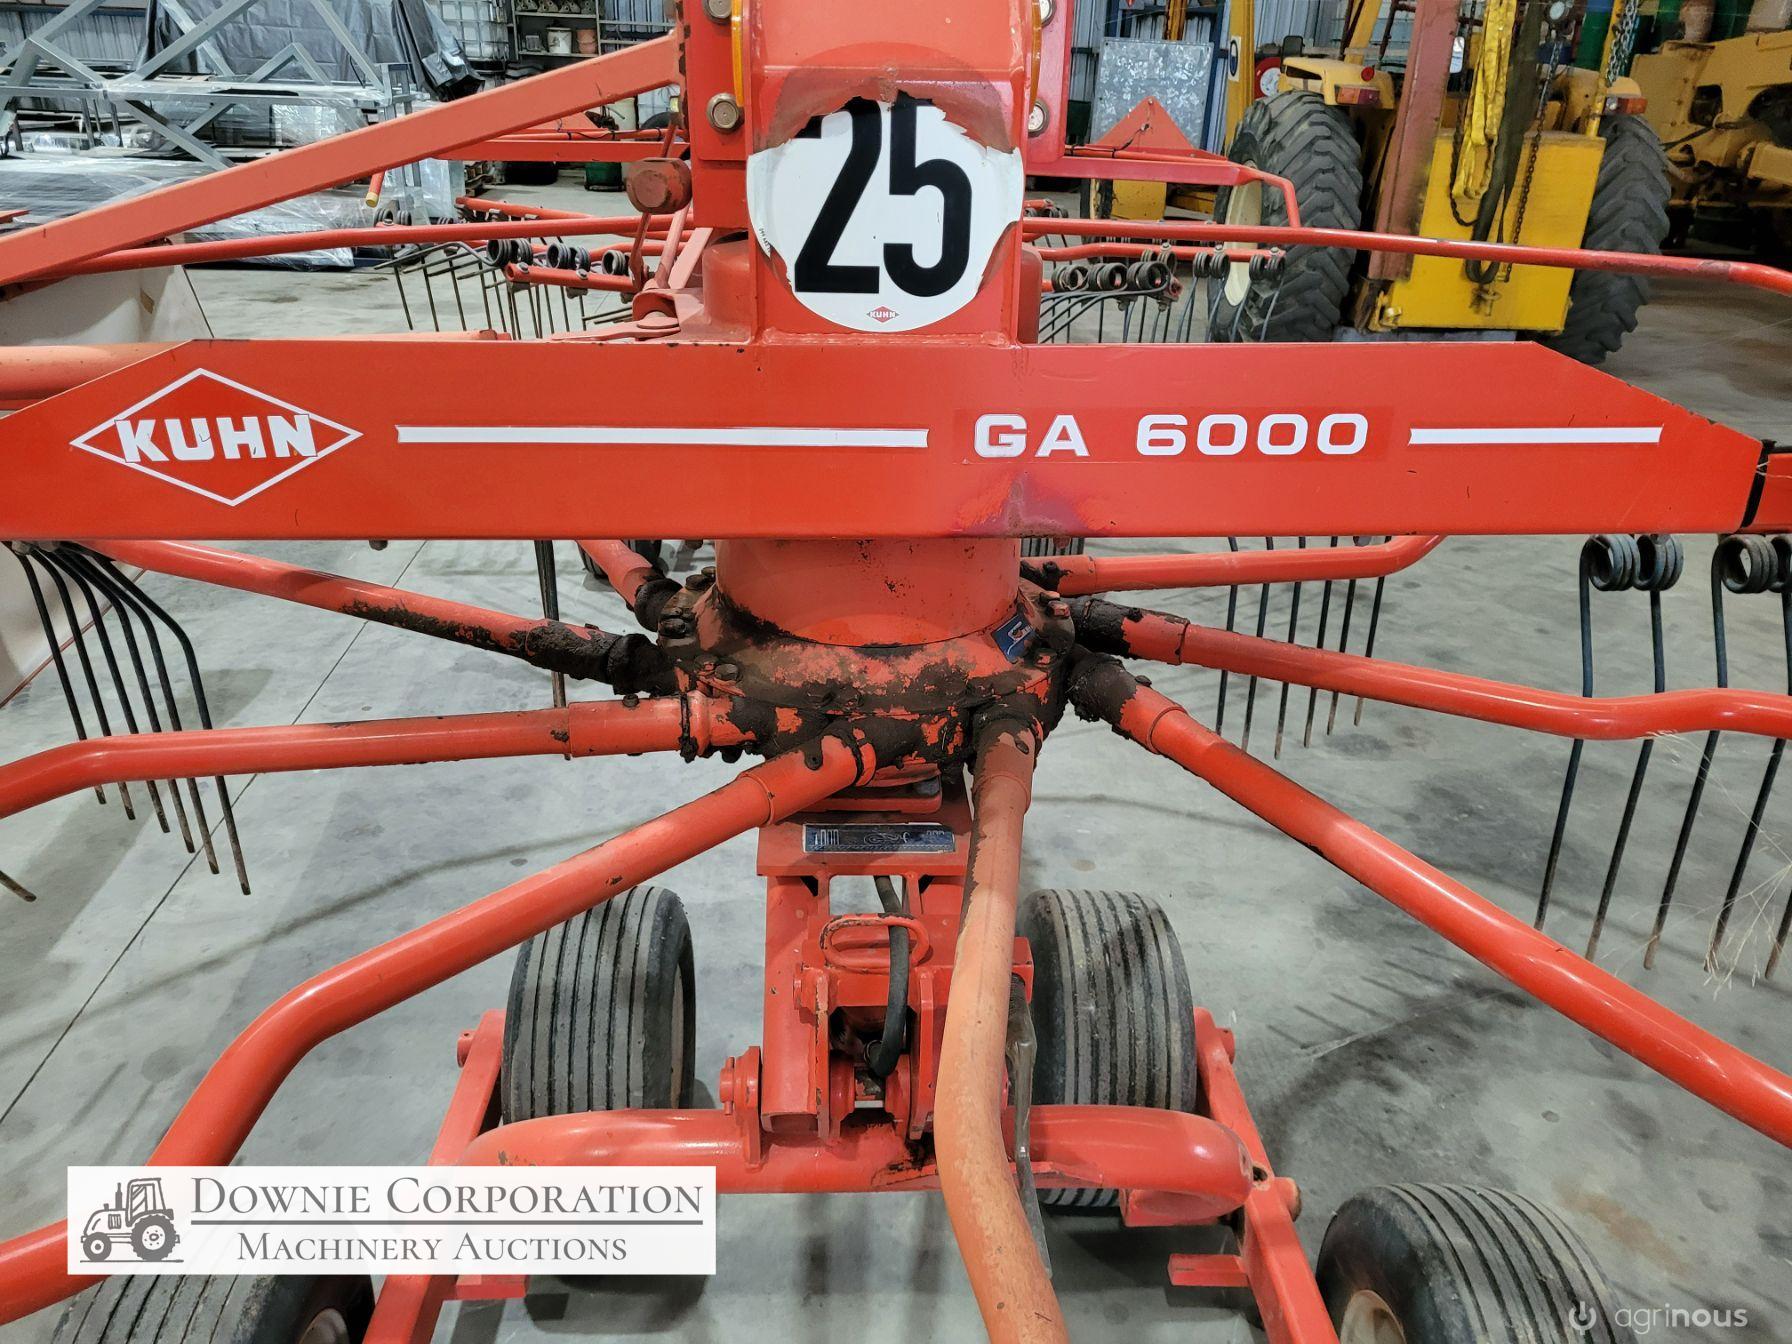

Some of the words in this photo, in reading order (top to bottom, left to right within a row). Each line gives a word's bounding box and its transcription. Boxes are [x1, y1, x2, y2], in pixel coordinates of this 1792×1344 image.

[794, 91, 972, 298] 25
[114, 413, 318, 463] KUHN
[974, 413, 1091, 458] GA
[1136, 412, 1369, 456] 6000
